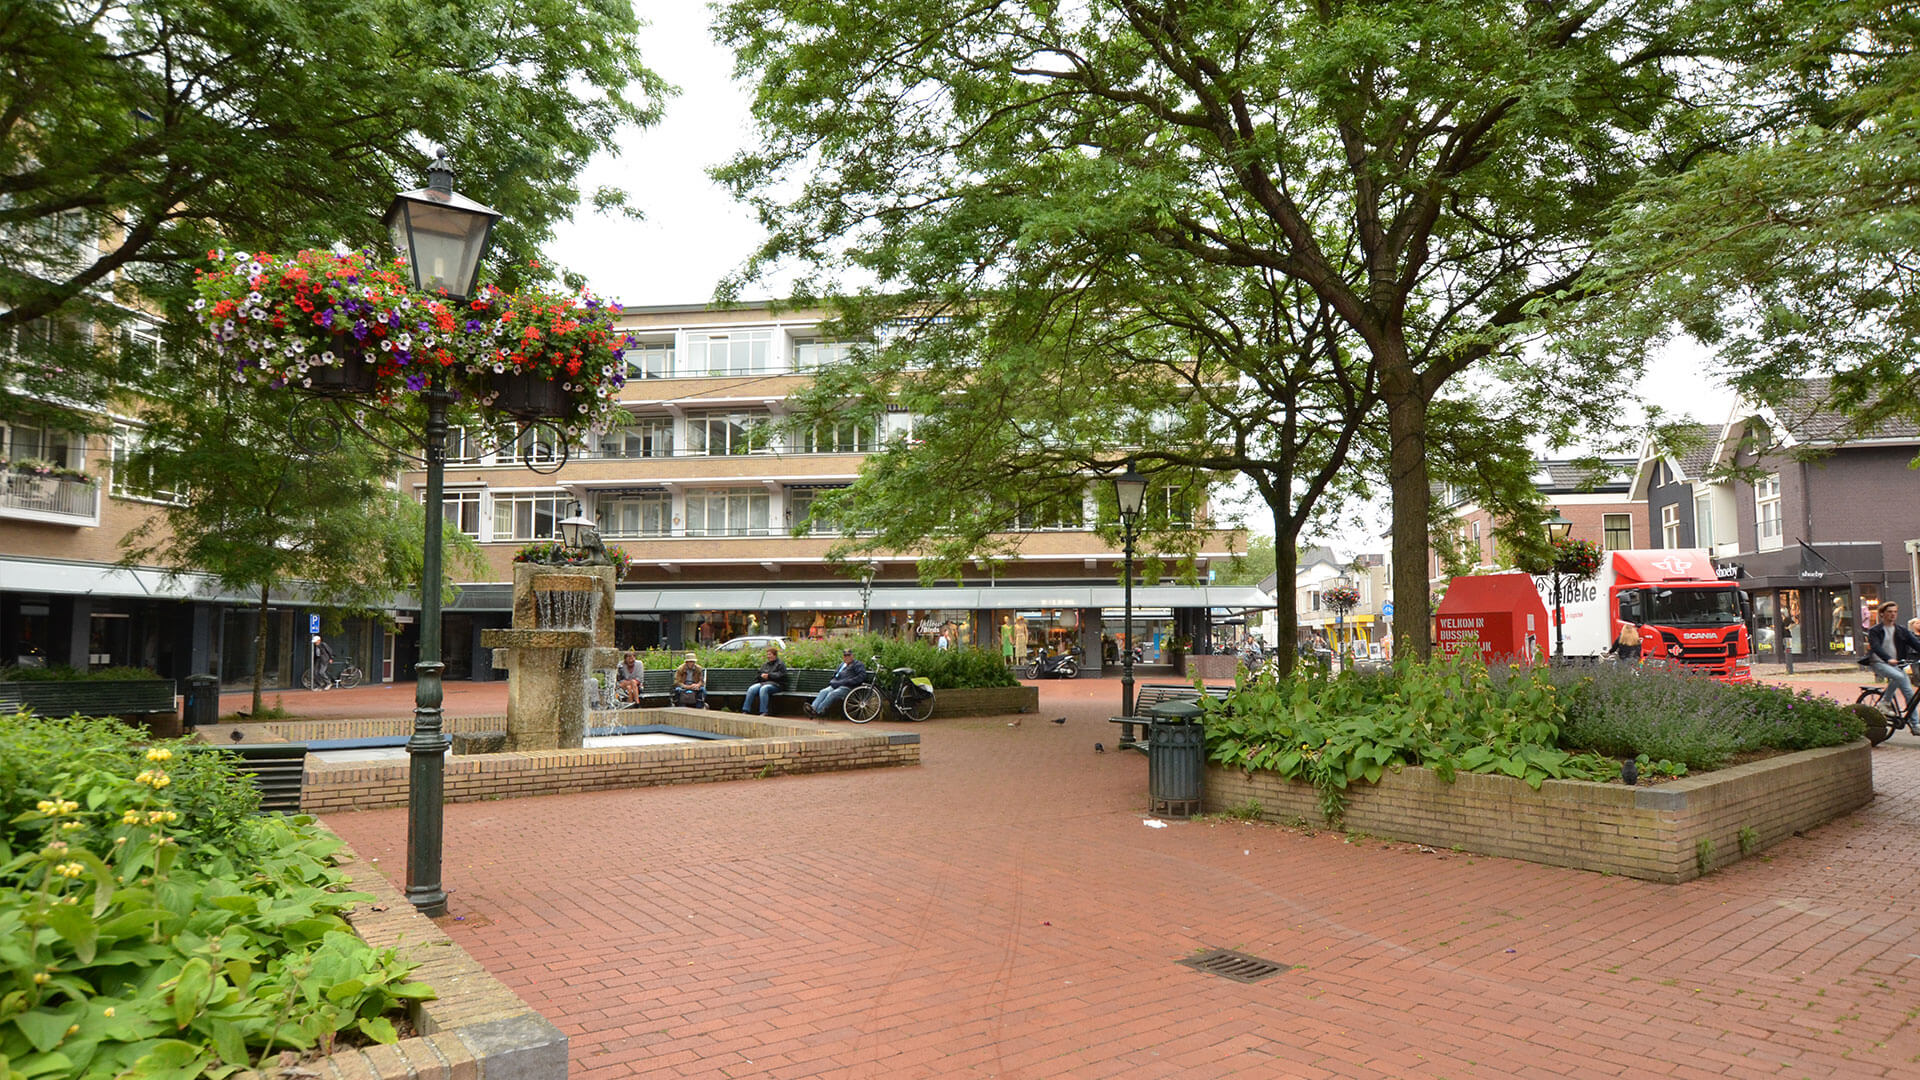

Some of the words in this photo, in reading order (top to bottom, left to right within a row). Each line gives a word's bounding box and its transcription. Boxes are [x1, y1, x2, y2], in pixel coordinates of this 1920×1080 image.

[1715, 562, 1738, 579] shoeby
[1440, 617, 1475, 628] WELKOM
[1476, 617, 1484, 628] IN
[1683, 632, 1718, 640] SCANIA
